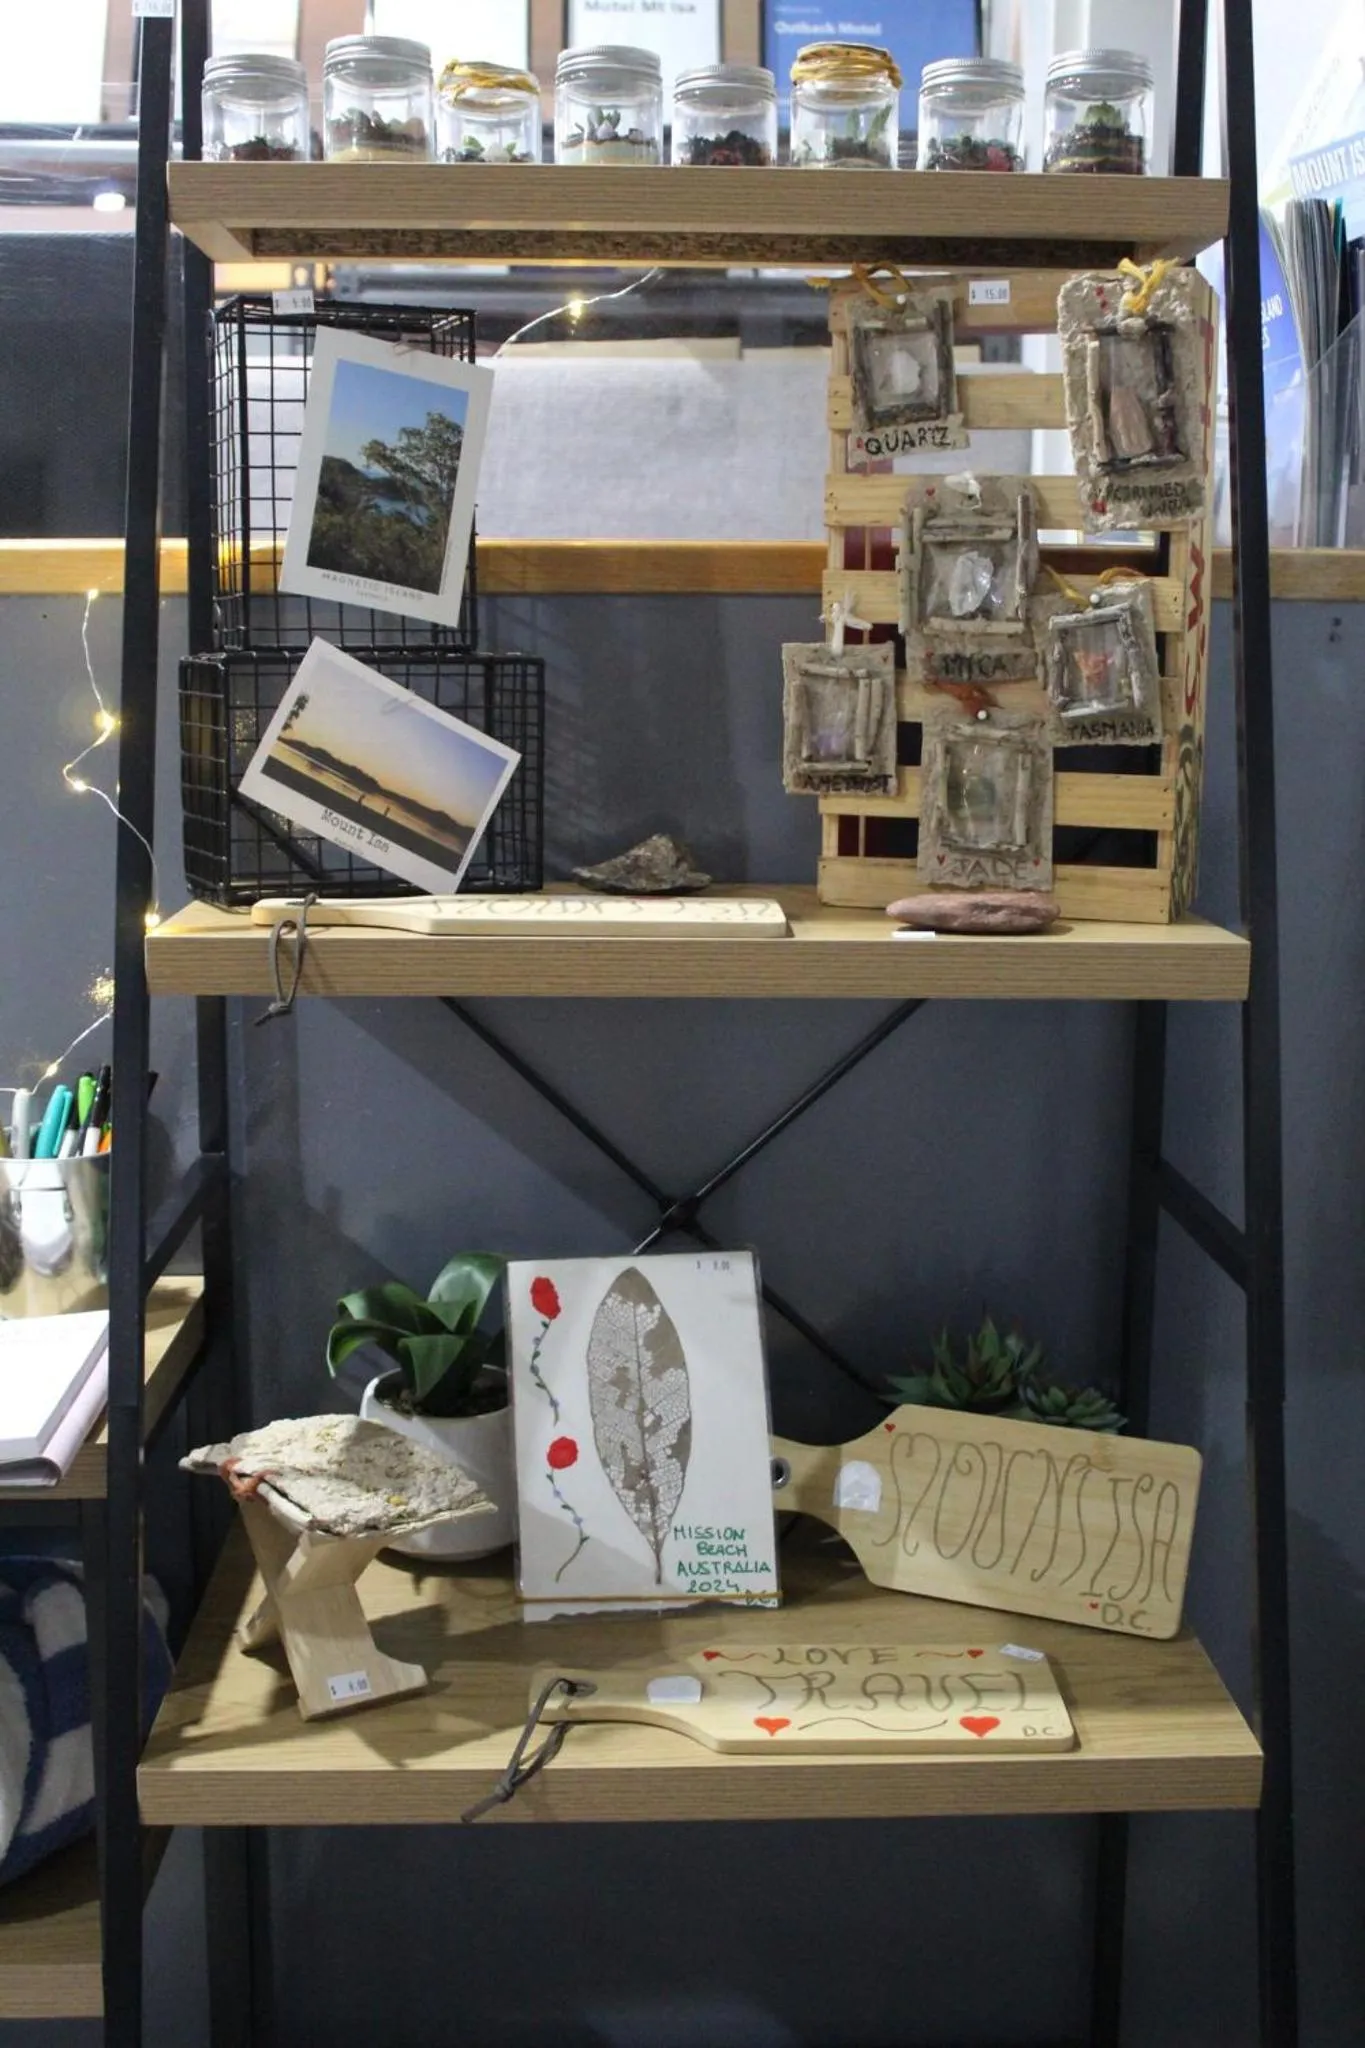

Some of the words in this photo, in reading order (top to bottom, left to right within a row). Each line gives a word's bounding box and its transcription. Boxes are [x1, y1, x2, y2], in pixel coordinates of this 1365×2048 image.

[1291, 146, 1349, 198] MOUNT
[864, 426, 951, 456] QUARTZ
[321, 807, 364, 840] Mount
[943, 859, 1028, 881] JADE
[872, 1432, 1112, 1587] MOUNT
[1079, 1473, 1179, 1605] ISA
[673, 1523, 746, 1541] MISSION
[696, 1540, 748, 1558] BEACH
[677, 1559, 772, 1578] AUSTRALIA
[686, 1579, 740, 1594] 2024
[775, 1646, 899, 1666] LOVE
[716, 1669, 1048, 1713] TRAVEL
